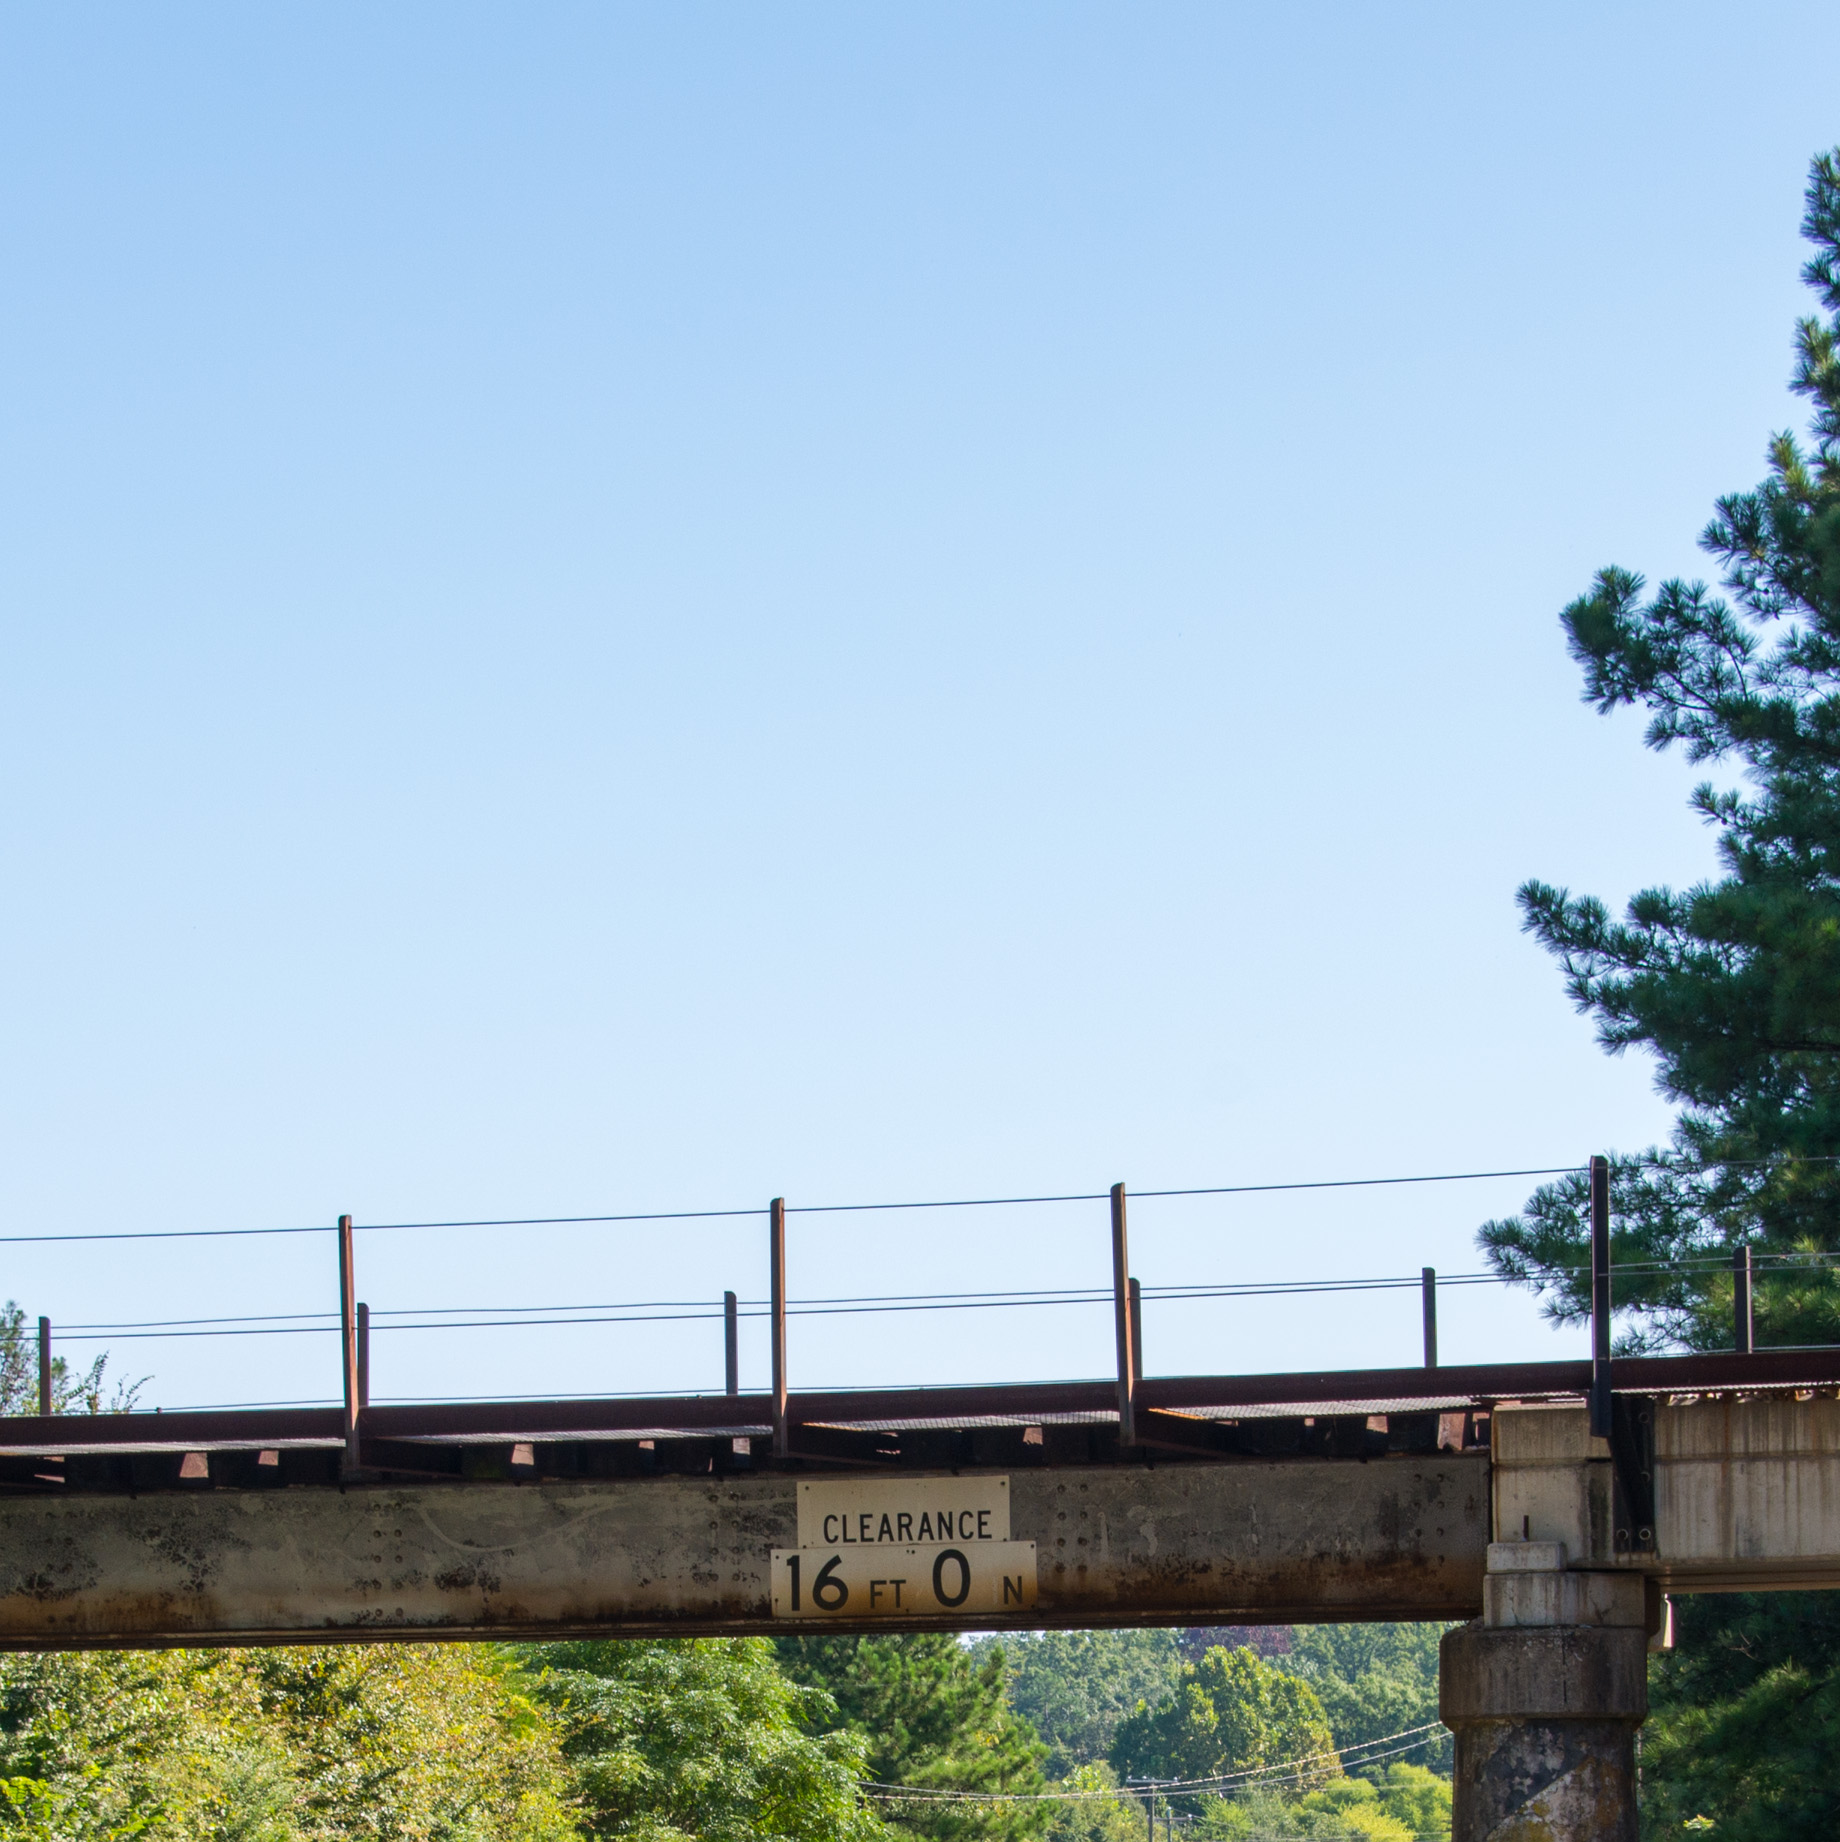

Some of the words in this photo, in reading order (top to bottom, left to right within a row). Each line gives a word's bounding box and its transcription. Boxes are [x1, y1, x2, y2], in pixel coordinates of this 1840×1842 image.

[822, 1510, 993, 1544] CLEARANCE
[786, 1555, 849, 1612] 16
[869, 1579, 907, 1609] FT
